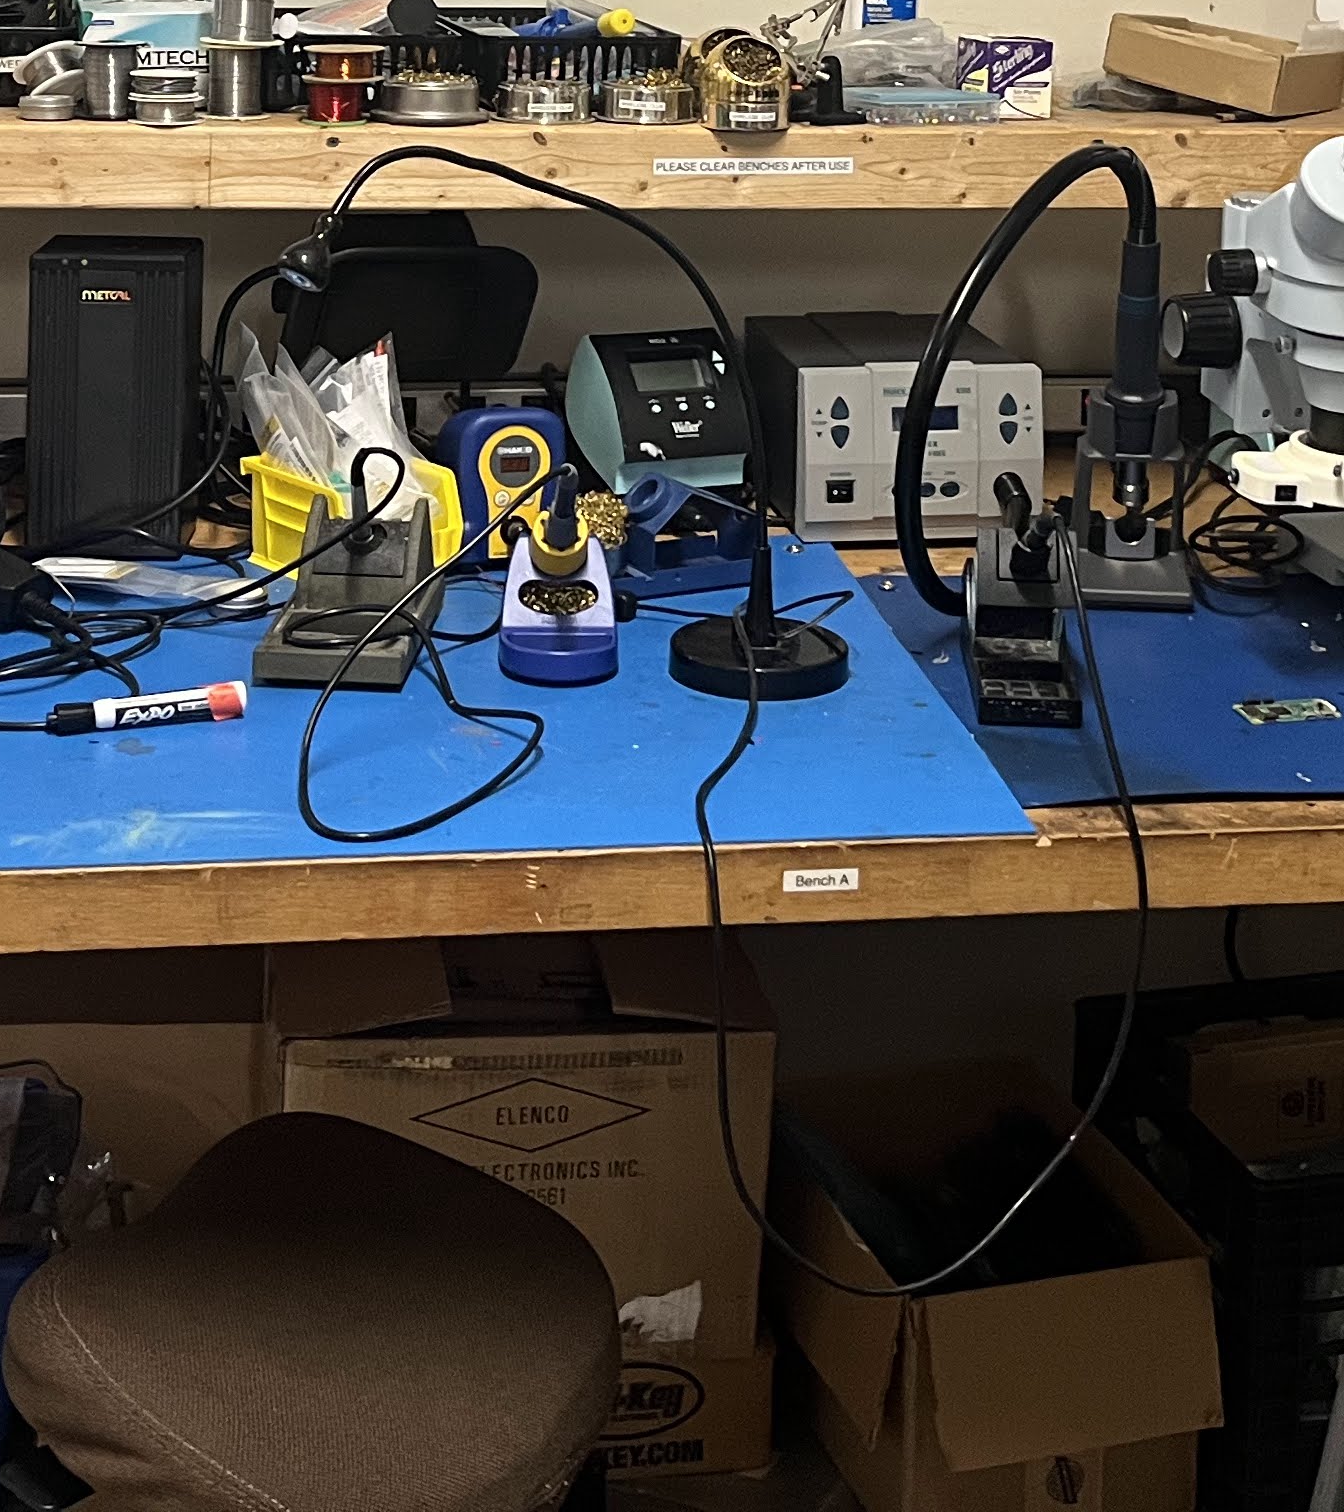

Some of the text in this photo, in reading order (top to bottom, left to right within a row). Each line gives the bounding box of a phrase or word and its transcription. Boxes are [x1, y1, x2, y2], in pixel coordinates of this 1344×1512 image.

[136, 50, 209, 65] MTECH
[656, 161, 850, 171] PLEASE CLEAR BENCHES AFTER USE
[120, 705, 175, 724] EXPO
[796, 873, 849, 887] Bench A
[496, 1105, 569, 1125] ELENCO
